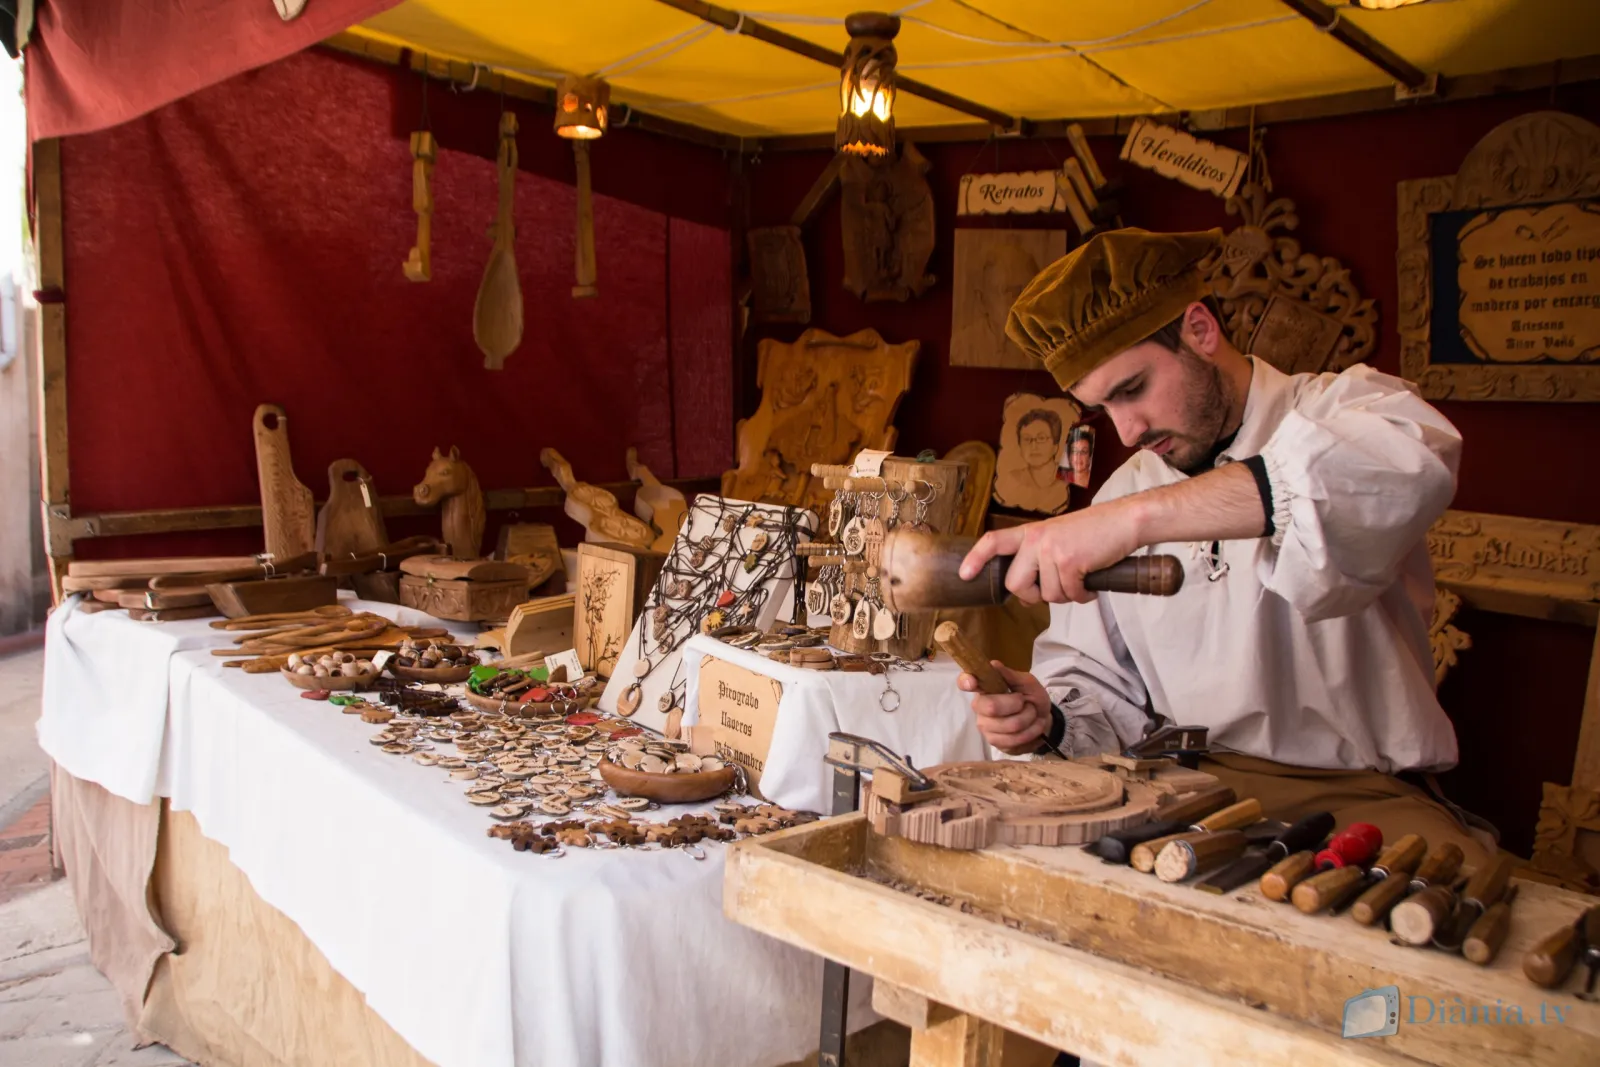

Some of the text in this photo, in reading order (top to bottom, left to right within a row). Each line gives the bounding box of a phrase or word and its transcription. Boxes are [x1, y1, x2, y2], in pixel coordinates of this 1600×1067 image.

[979, 183, 1044, 205] Retratos
[1473, 254, 1496, 270] Se
[1499, 253, 1537, 269] hacen
[1541, 249, 1572, 264] todo
[1488, 271, 1588, 290] de trabajos en
[1470, 297, 1520, 312] madera
[1524, 297, 1548, 312] por
[734, 749, 763, 773] nombre
